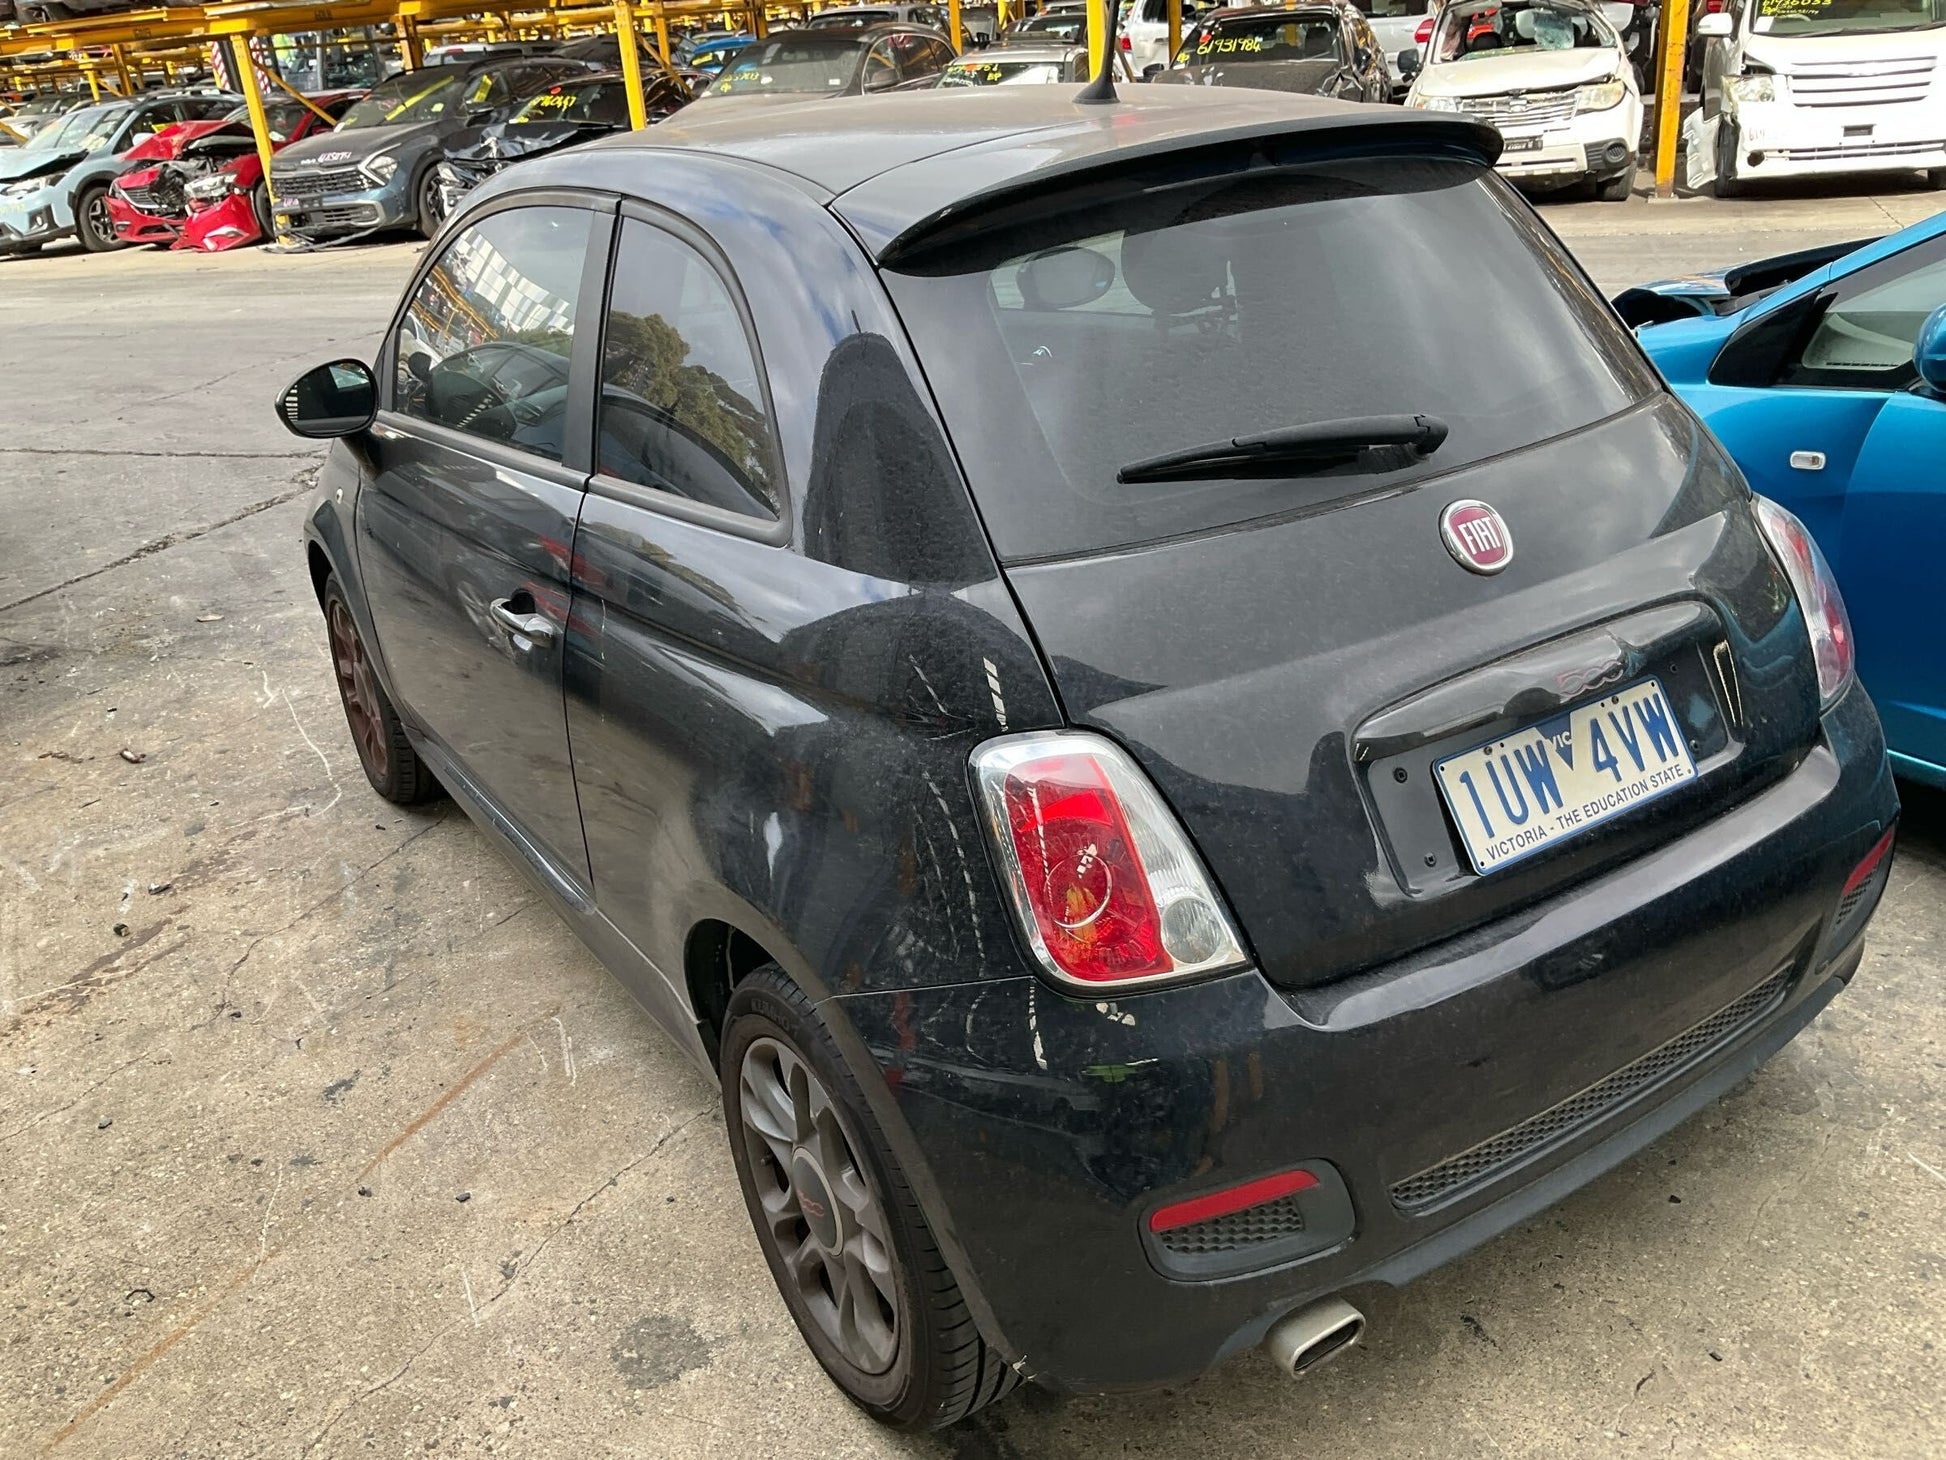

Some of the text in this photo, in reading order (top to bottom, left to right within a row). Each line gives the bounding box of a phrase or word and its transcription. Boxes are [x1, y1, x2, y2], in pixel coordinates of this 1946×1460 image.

[1197, 38, 1261, 55] 61931984
[1458, 516, 1501, 555] FIAT
[1549, 731, 1572, 751] VIC
[1459, 693, 1679, 839] 1UW 4VW
[1486, 824, 1548, 861] VICTORIA
[1556, 808, 1582, 831] THE
[1582, 782, 1650, 819] EDUCATION
[1650, 763, 1685, 789] STATE
